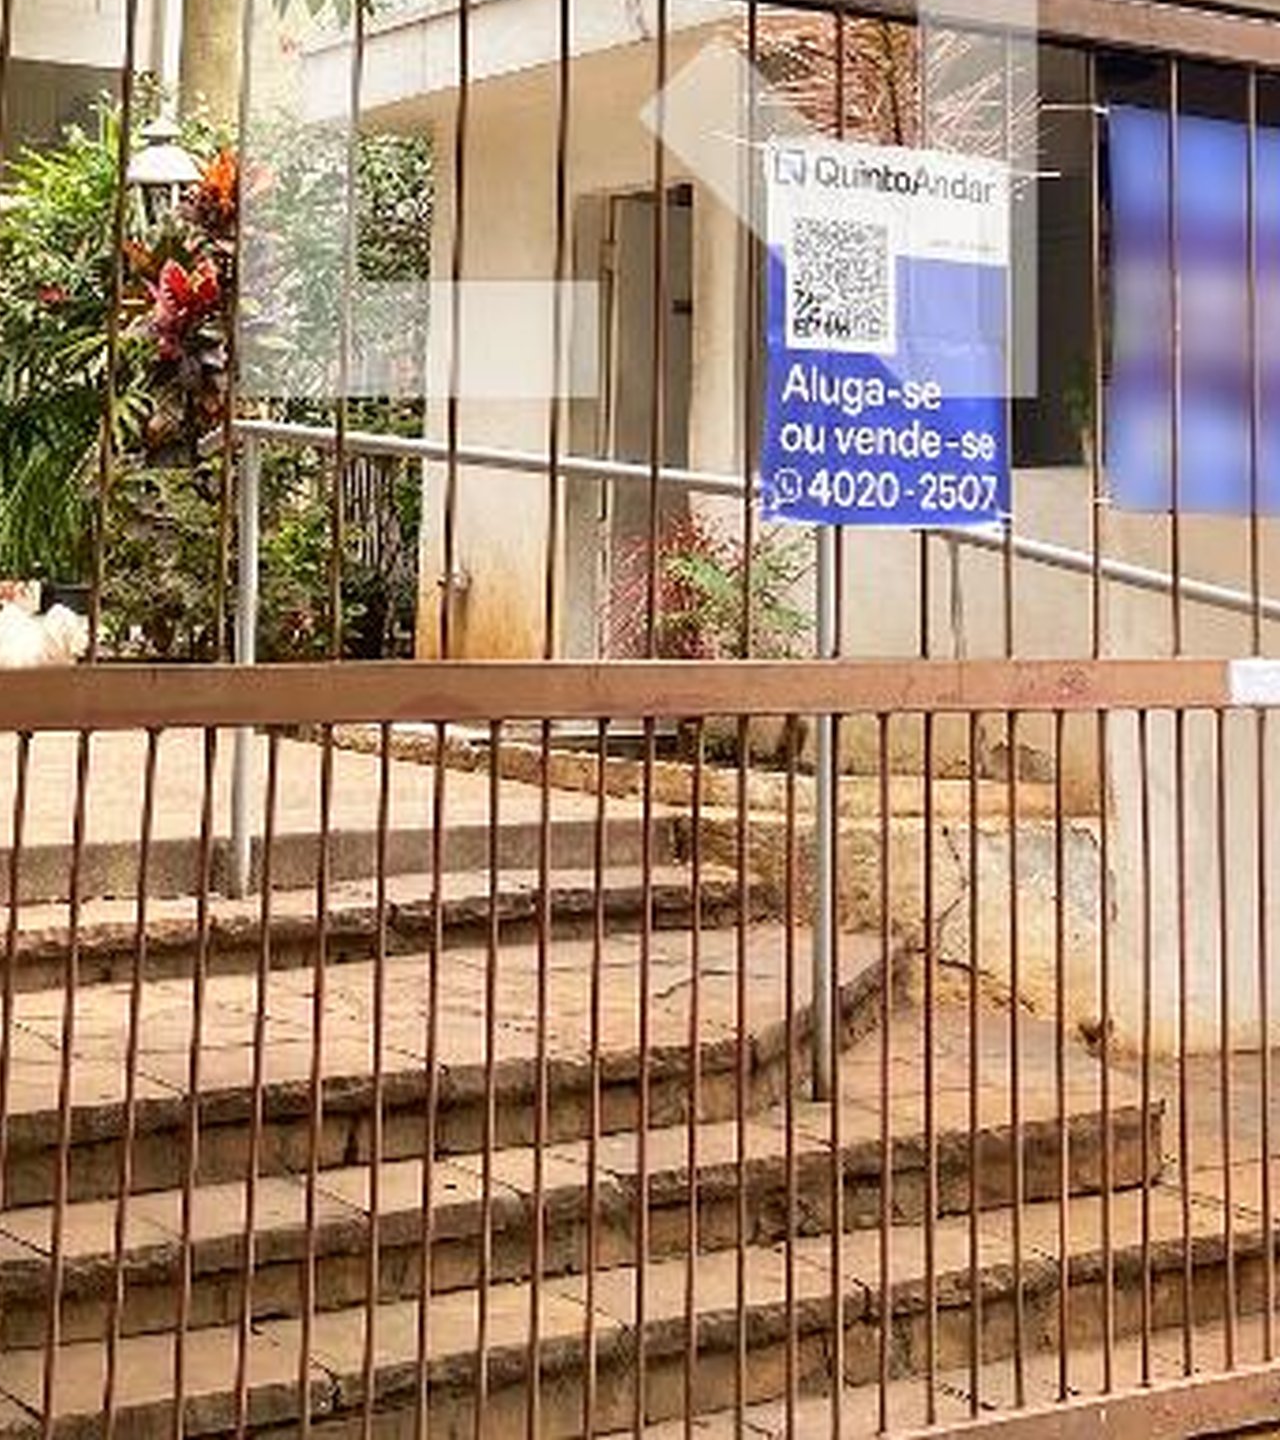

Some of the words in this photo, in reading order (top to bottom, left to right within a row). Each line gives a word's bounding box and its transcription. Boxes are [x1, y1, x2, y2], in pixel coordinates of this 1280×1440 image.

[815, 156, 996, 204] QuintoAndar
[781, 363, 942, 416] Aluga-se
[780, 422, 826, 455] ou
[833, 419, 997, 462] vende-se
